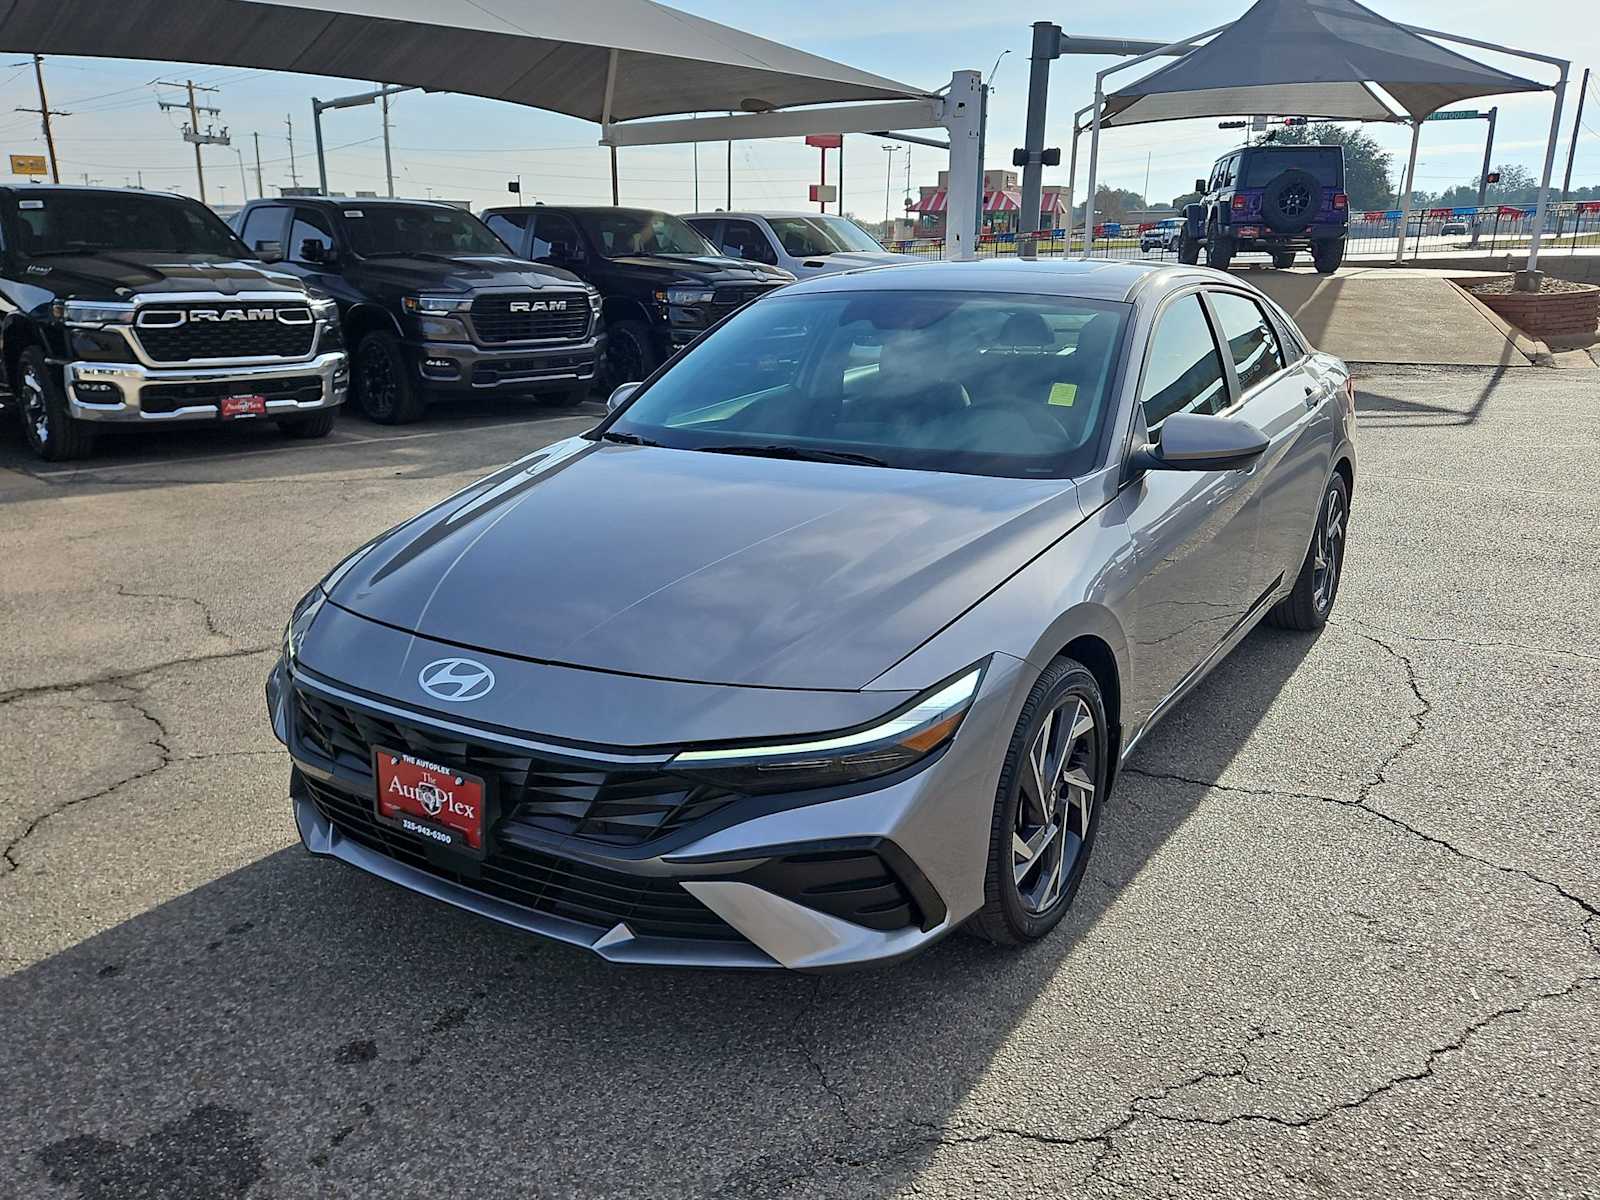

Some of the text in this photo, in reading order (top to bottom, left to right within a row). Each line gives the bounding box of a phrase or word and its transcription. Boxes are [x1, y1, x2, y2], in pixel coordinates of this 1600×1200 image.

[510, 301, 566, 311] RAM
[189, 309, 274, 321] RAM
[402, 755, 450, 775] THE AUTOPLEX
[422, 772, 436, 785] The
[389, 775, 475, 819] AutoPlex
[402, 819, 452, 844] 325-942-6200
